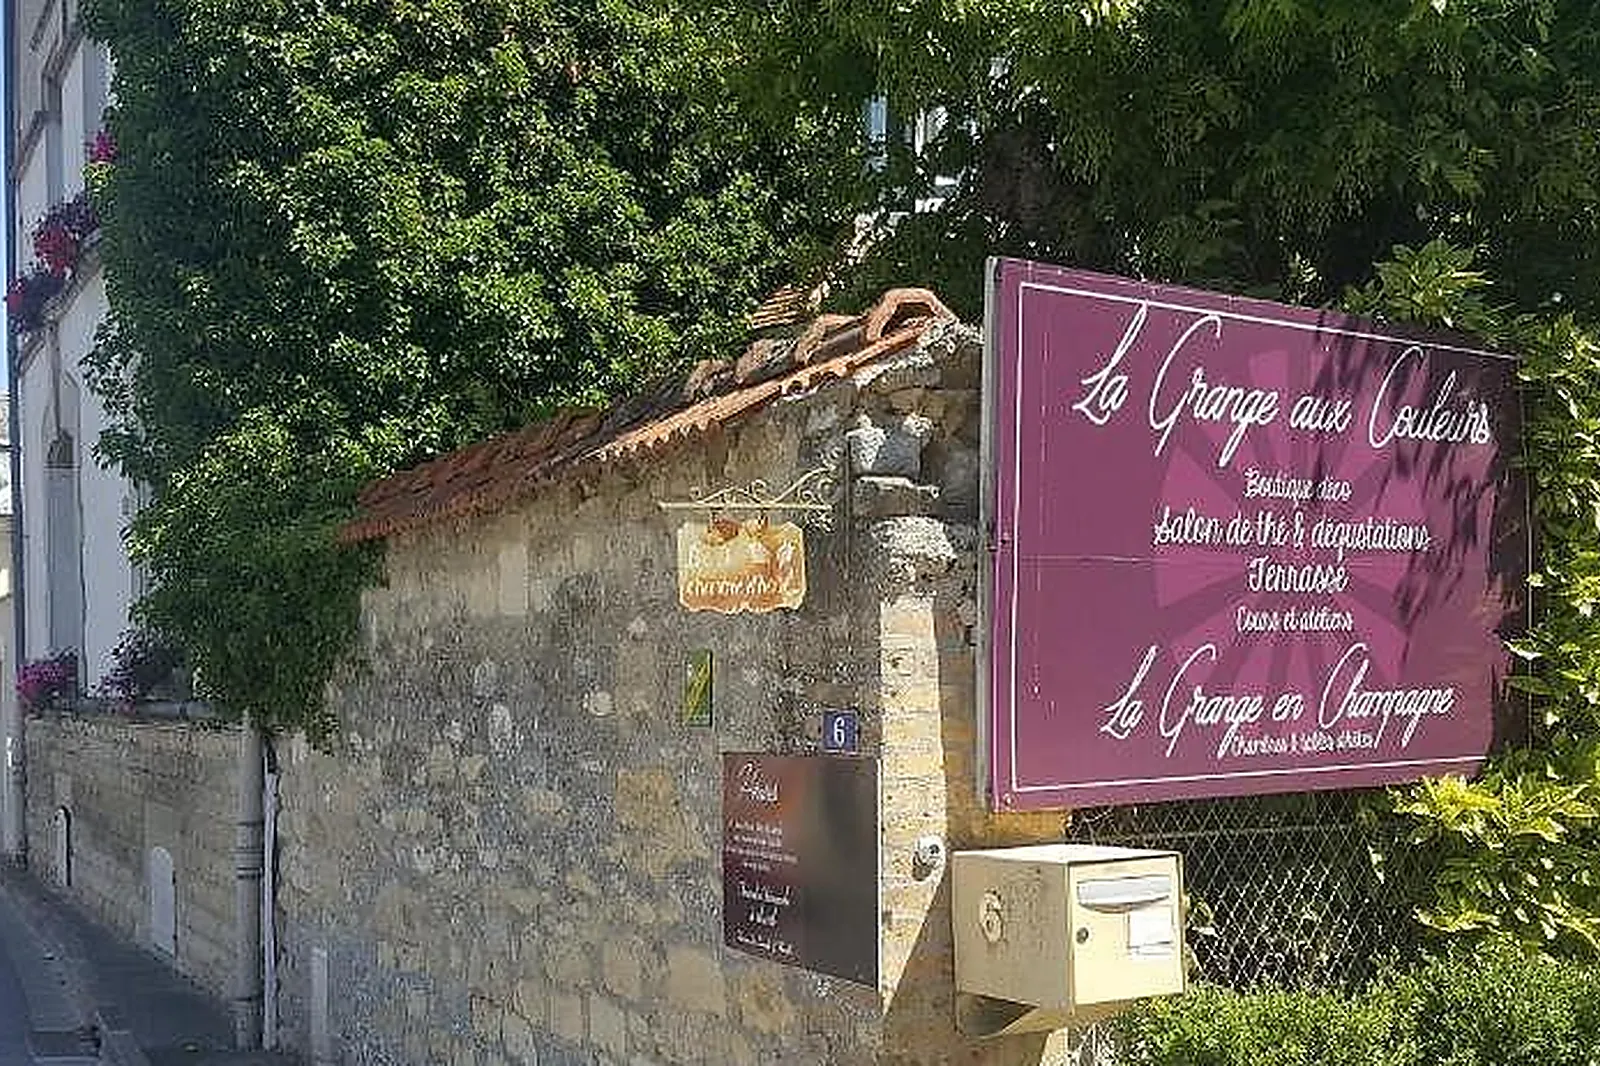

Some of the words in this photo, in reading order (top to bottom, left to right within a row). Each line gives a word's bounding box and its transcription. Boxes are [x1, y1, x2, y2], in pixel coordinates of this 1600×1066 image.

[1072, 301, 1148, 425] La
[1149, 314, 1281, 467] Grange
[1290, 395, 1352, 433] aux
[1369, 346, 1491, 449] Couleurs
[1243, 468, 1312, 508] Boutique
[1154, 506, 1223, 545] Salon
[1226, 512, 1251, 545] de
[1254, 510, 1290, 545] thé
[1311, 517, 1432, 561] dégustations
[1248, 555, 1349, 593] Terrasse
[1100, 645, 1157, 739] La
[1159, 643, 1264, 758] Grange
[1272, 694, 1305, 722] en
[1317, 643, 1456, 748] Champagne
[833, 716, 846, 748] 6
